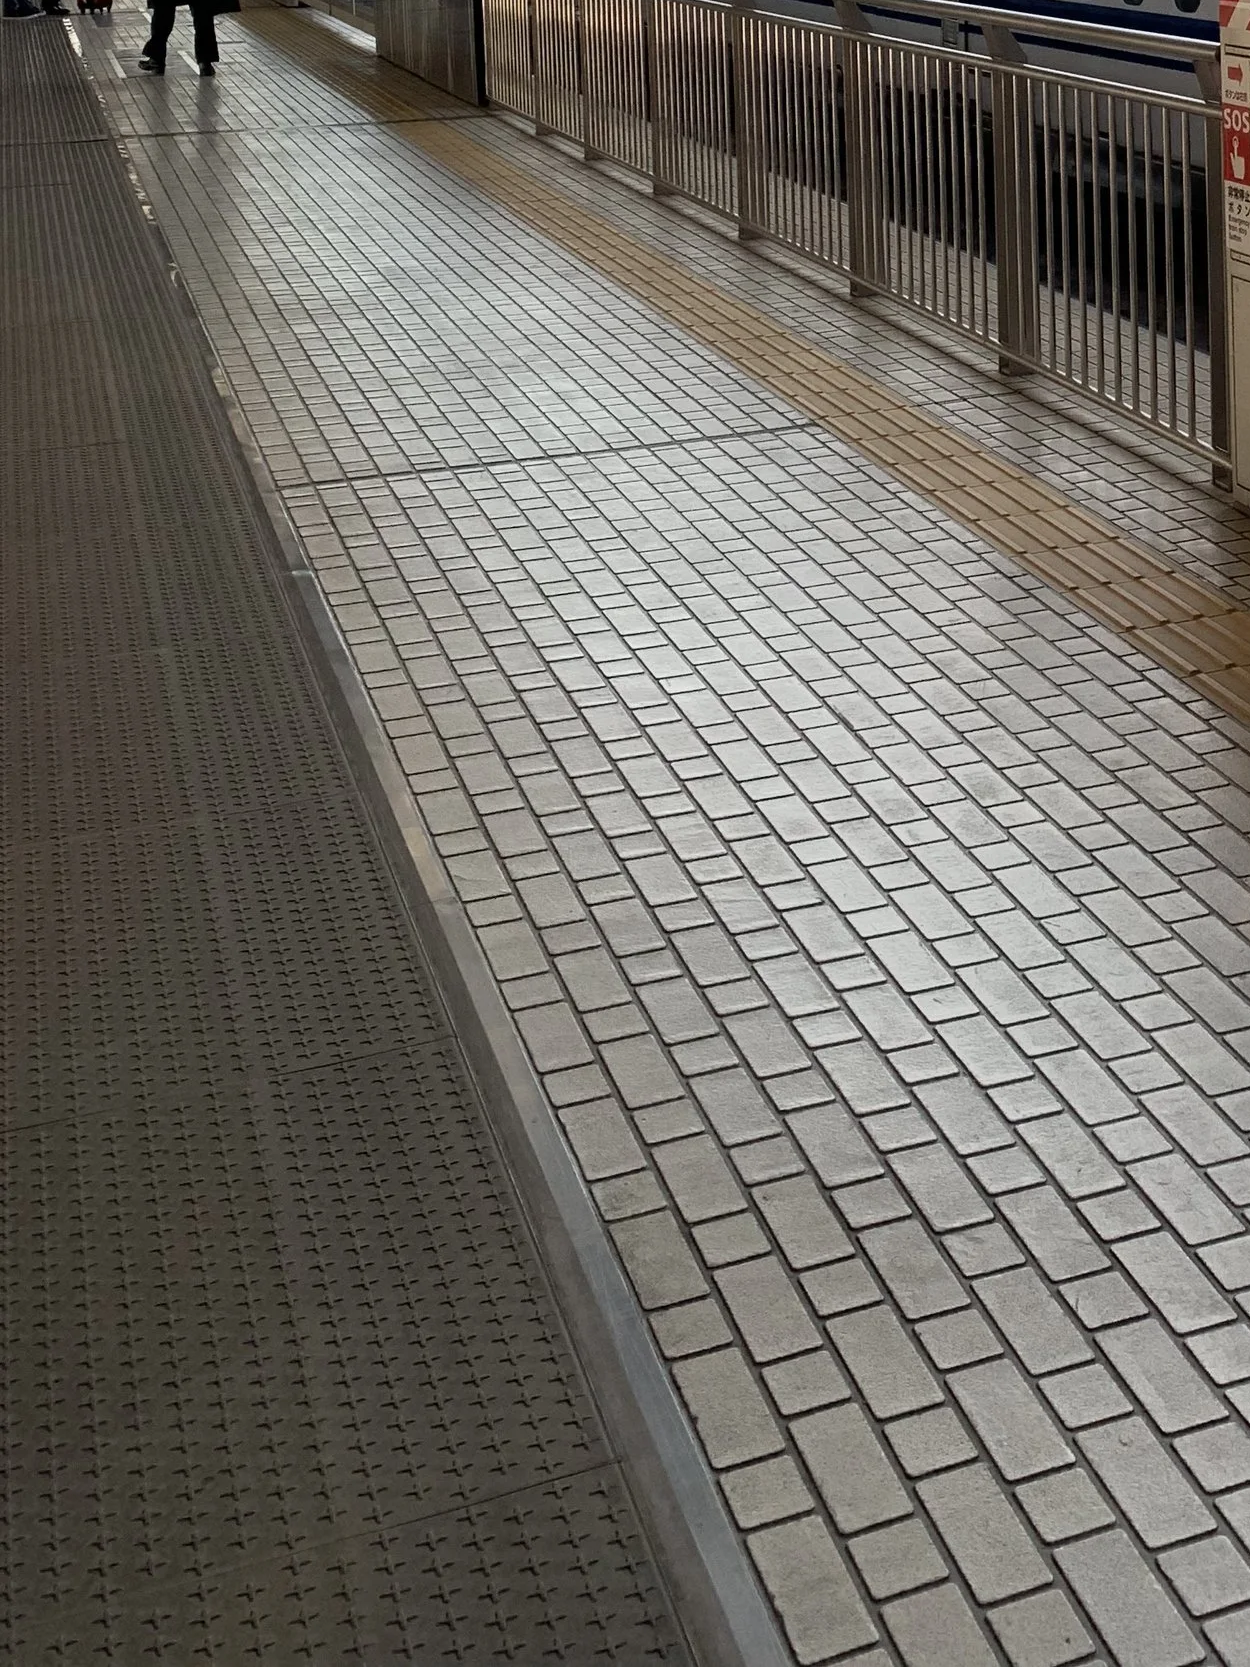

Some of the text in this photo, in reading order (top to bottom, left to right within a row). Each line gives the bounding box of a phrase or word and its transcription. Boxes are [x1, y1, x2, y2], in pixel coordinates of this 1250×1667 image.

[1223, 108, 1250, 134] SOS
[1228, 185, 1250, 203] 非常停止
[1228, 201, 1250, 218] ボタン
